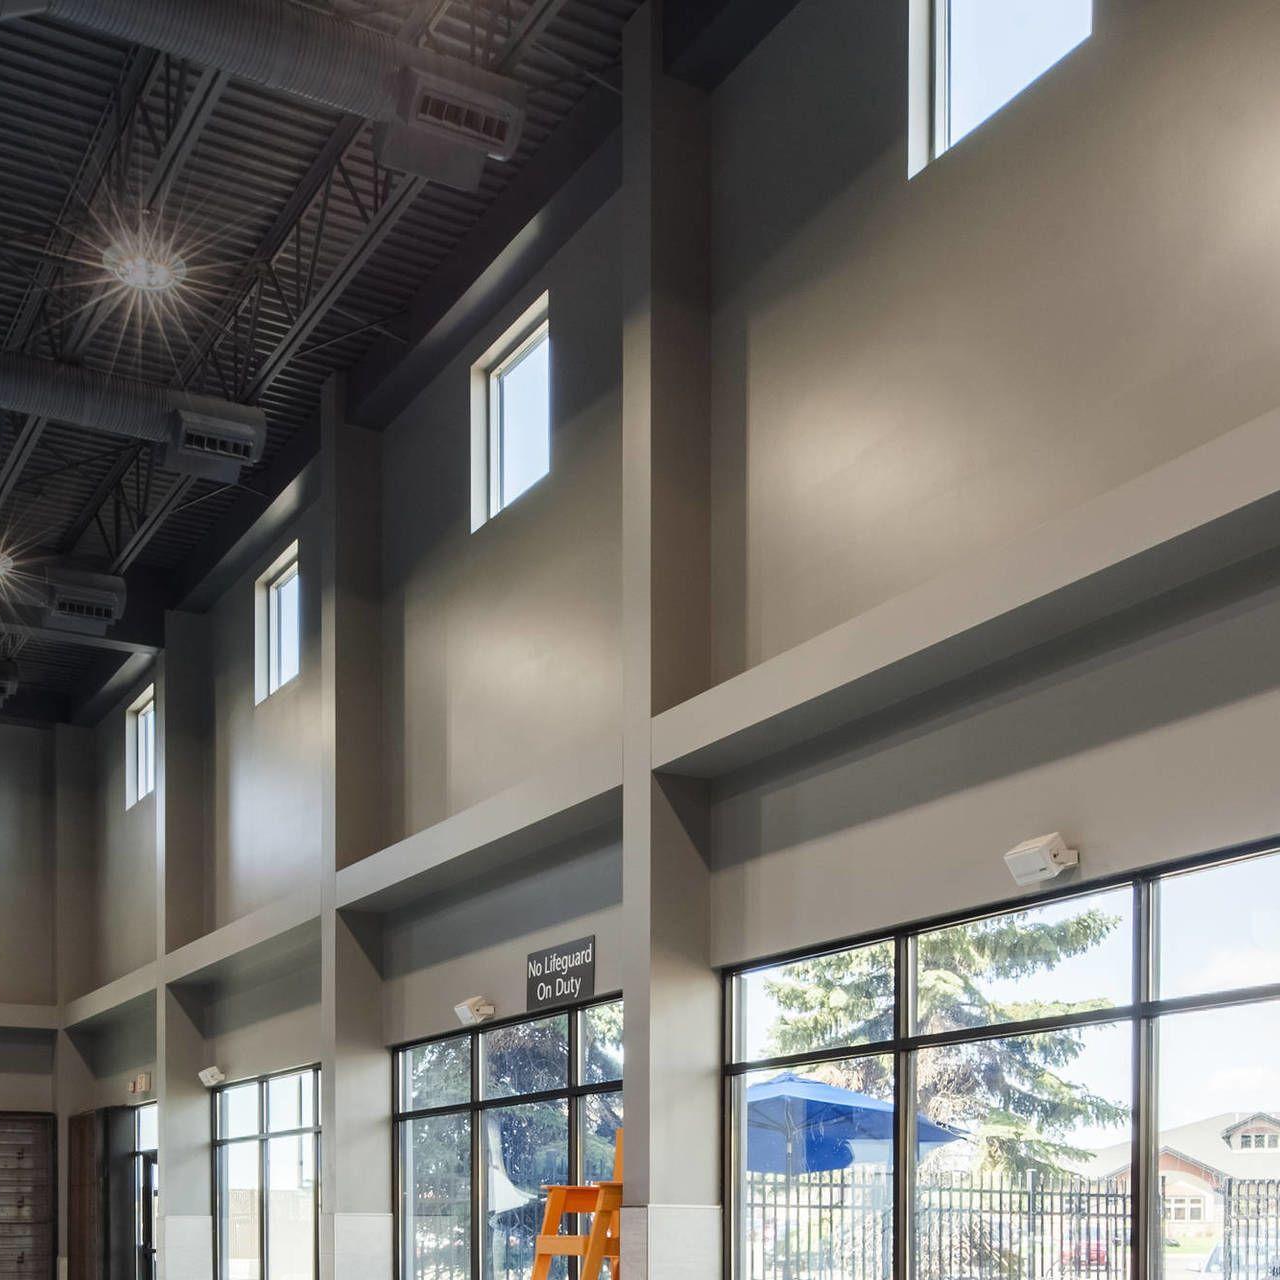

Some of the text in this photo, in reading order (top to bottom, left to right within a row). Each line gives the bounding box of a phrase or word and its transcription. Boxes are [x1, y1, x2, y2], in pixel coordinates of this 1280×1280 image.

[528, 943, 592, 979] No Lifeguard
[537, 976, 582, 1001] On Duty
